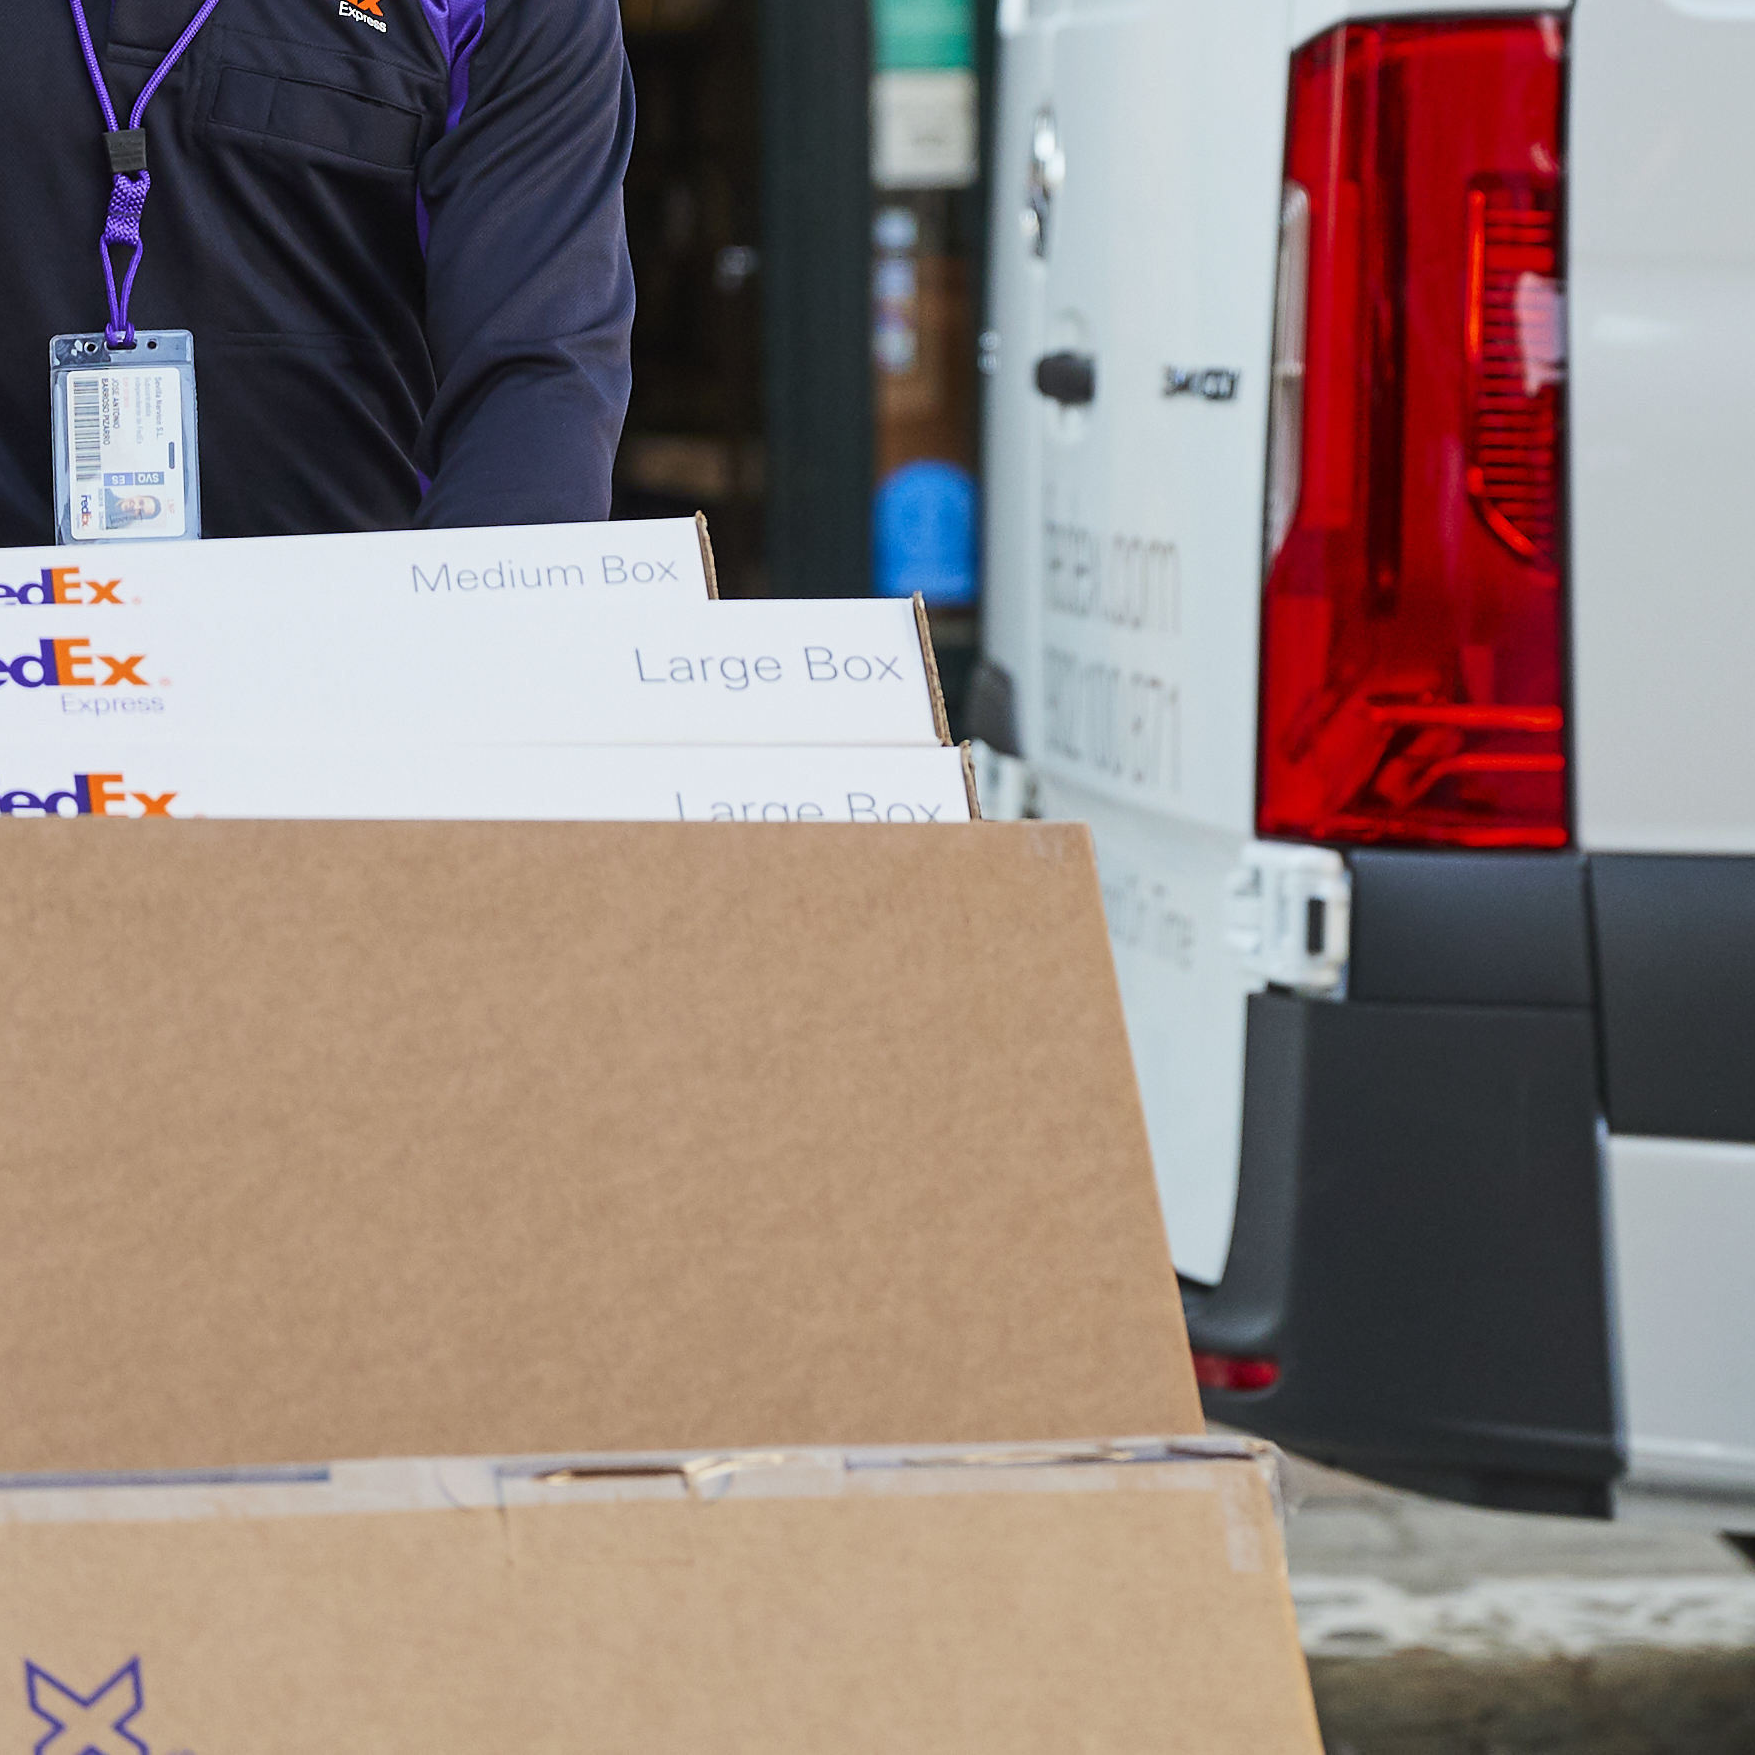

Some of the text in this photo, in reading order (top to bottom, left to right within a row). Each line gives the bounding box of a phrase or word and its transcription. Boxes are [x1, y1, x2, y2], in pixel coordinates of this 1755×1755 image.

[338, 0, 387, 33] Express
[101, 377, 111, 445] BARROSO PIZARRO
[111, 377, 121, 429] JOSE ANTONIO
[110, 472, 160, 485] SVQ ES
[80, 494, 92, 528] FedEx
[411, 555, 679, 593] Medium Box
[635, 646, 904, 690] Large Box
[60, 692, 165, 716] Express
[846, 792, 942, 823] Box
